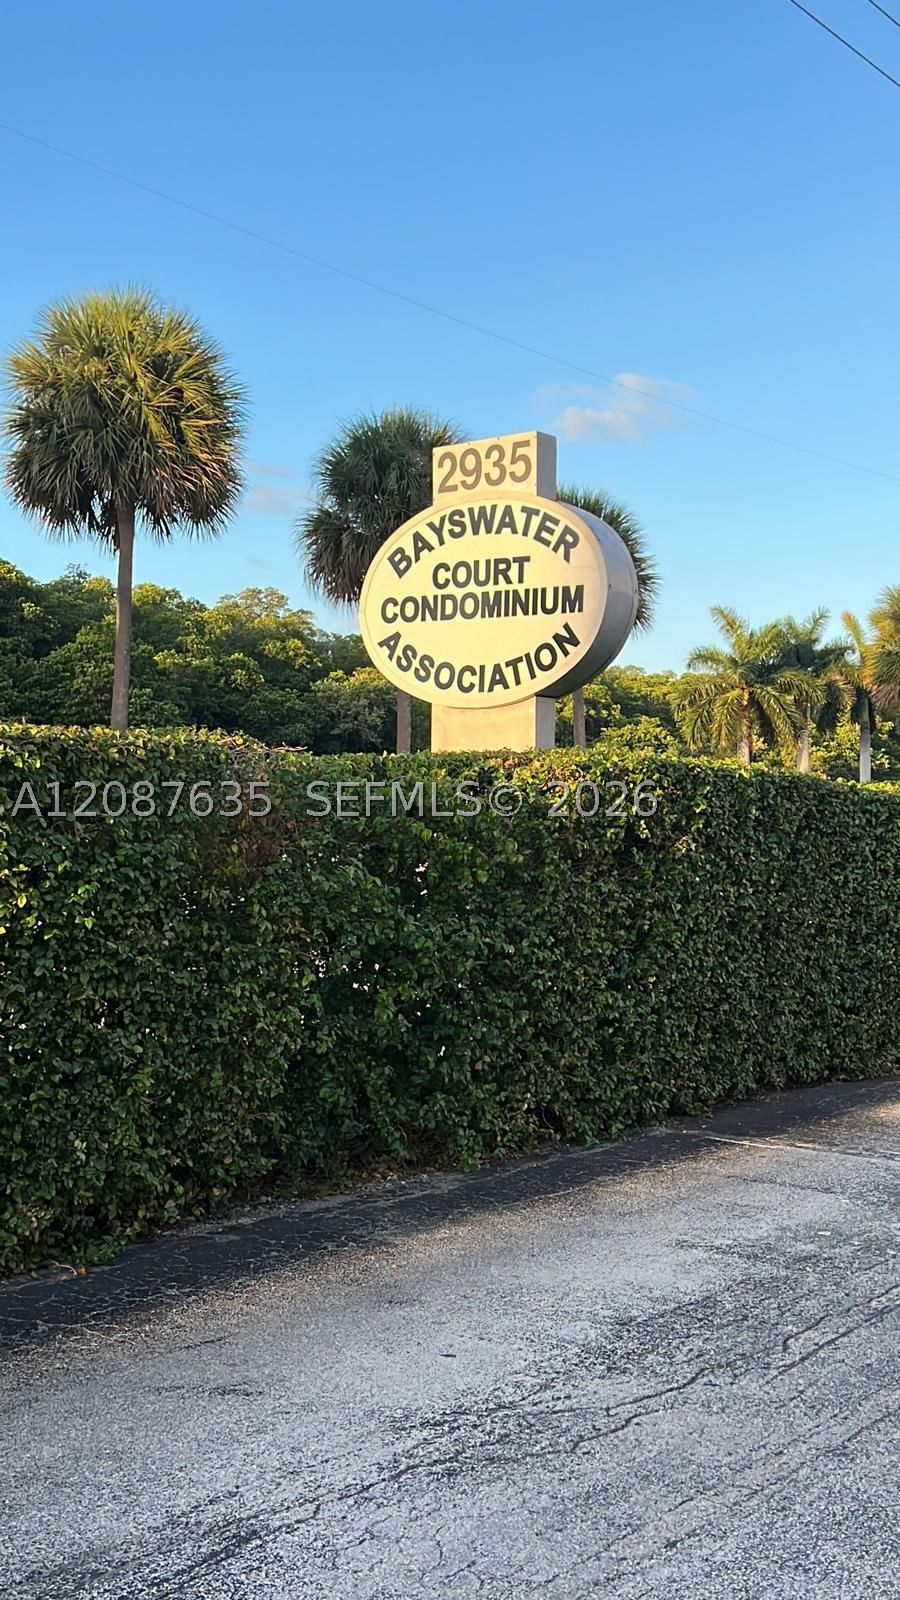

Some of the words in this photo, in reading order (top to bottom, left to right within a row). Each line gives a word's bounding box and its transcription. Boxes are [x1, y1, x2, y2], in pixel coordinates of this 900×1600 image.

[437, 440, 532, 494] 2935
[387, 504, 580, 579] BAYSWATER
[432, 556, 531, 590] COURT
[381, 585, 585, 625] CONDOMINIUM
[378, 622, 581, 694] ASSOCIATION
